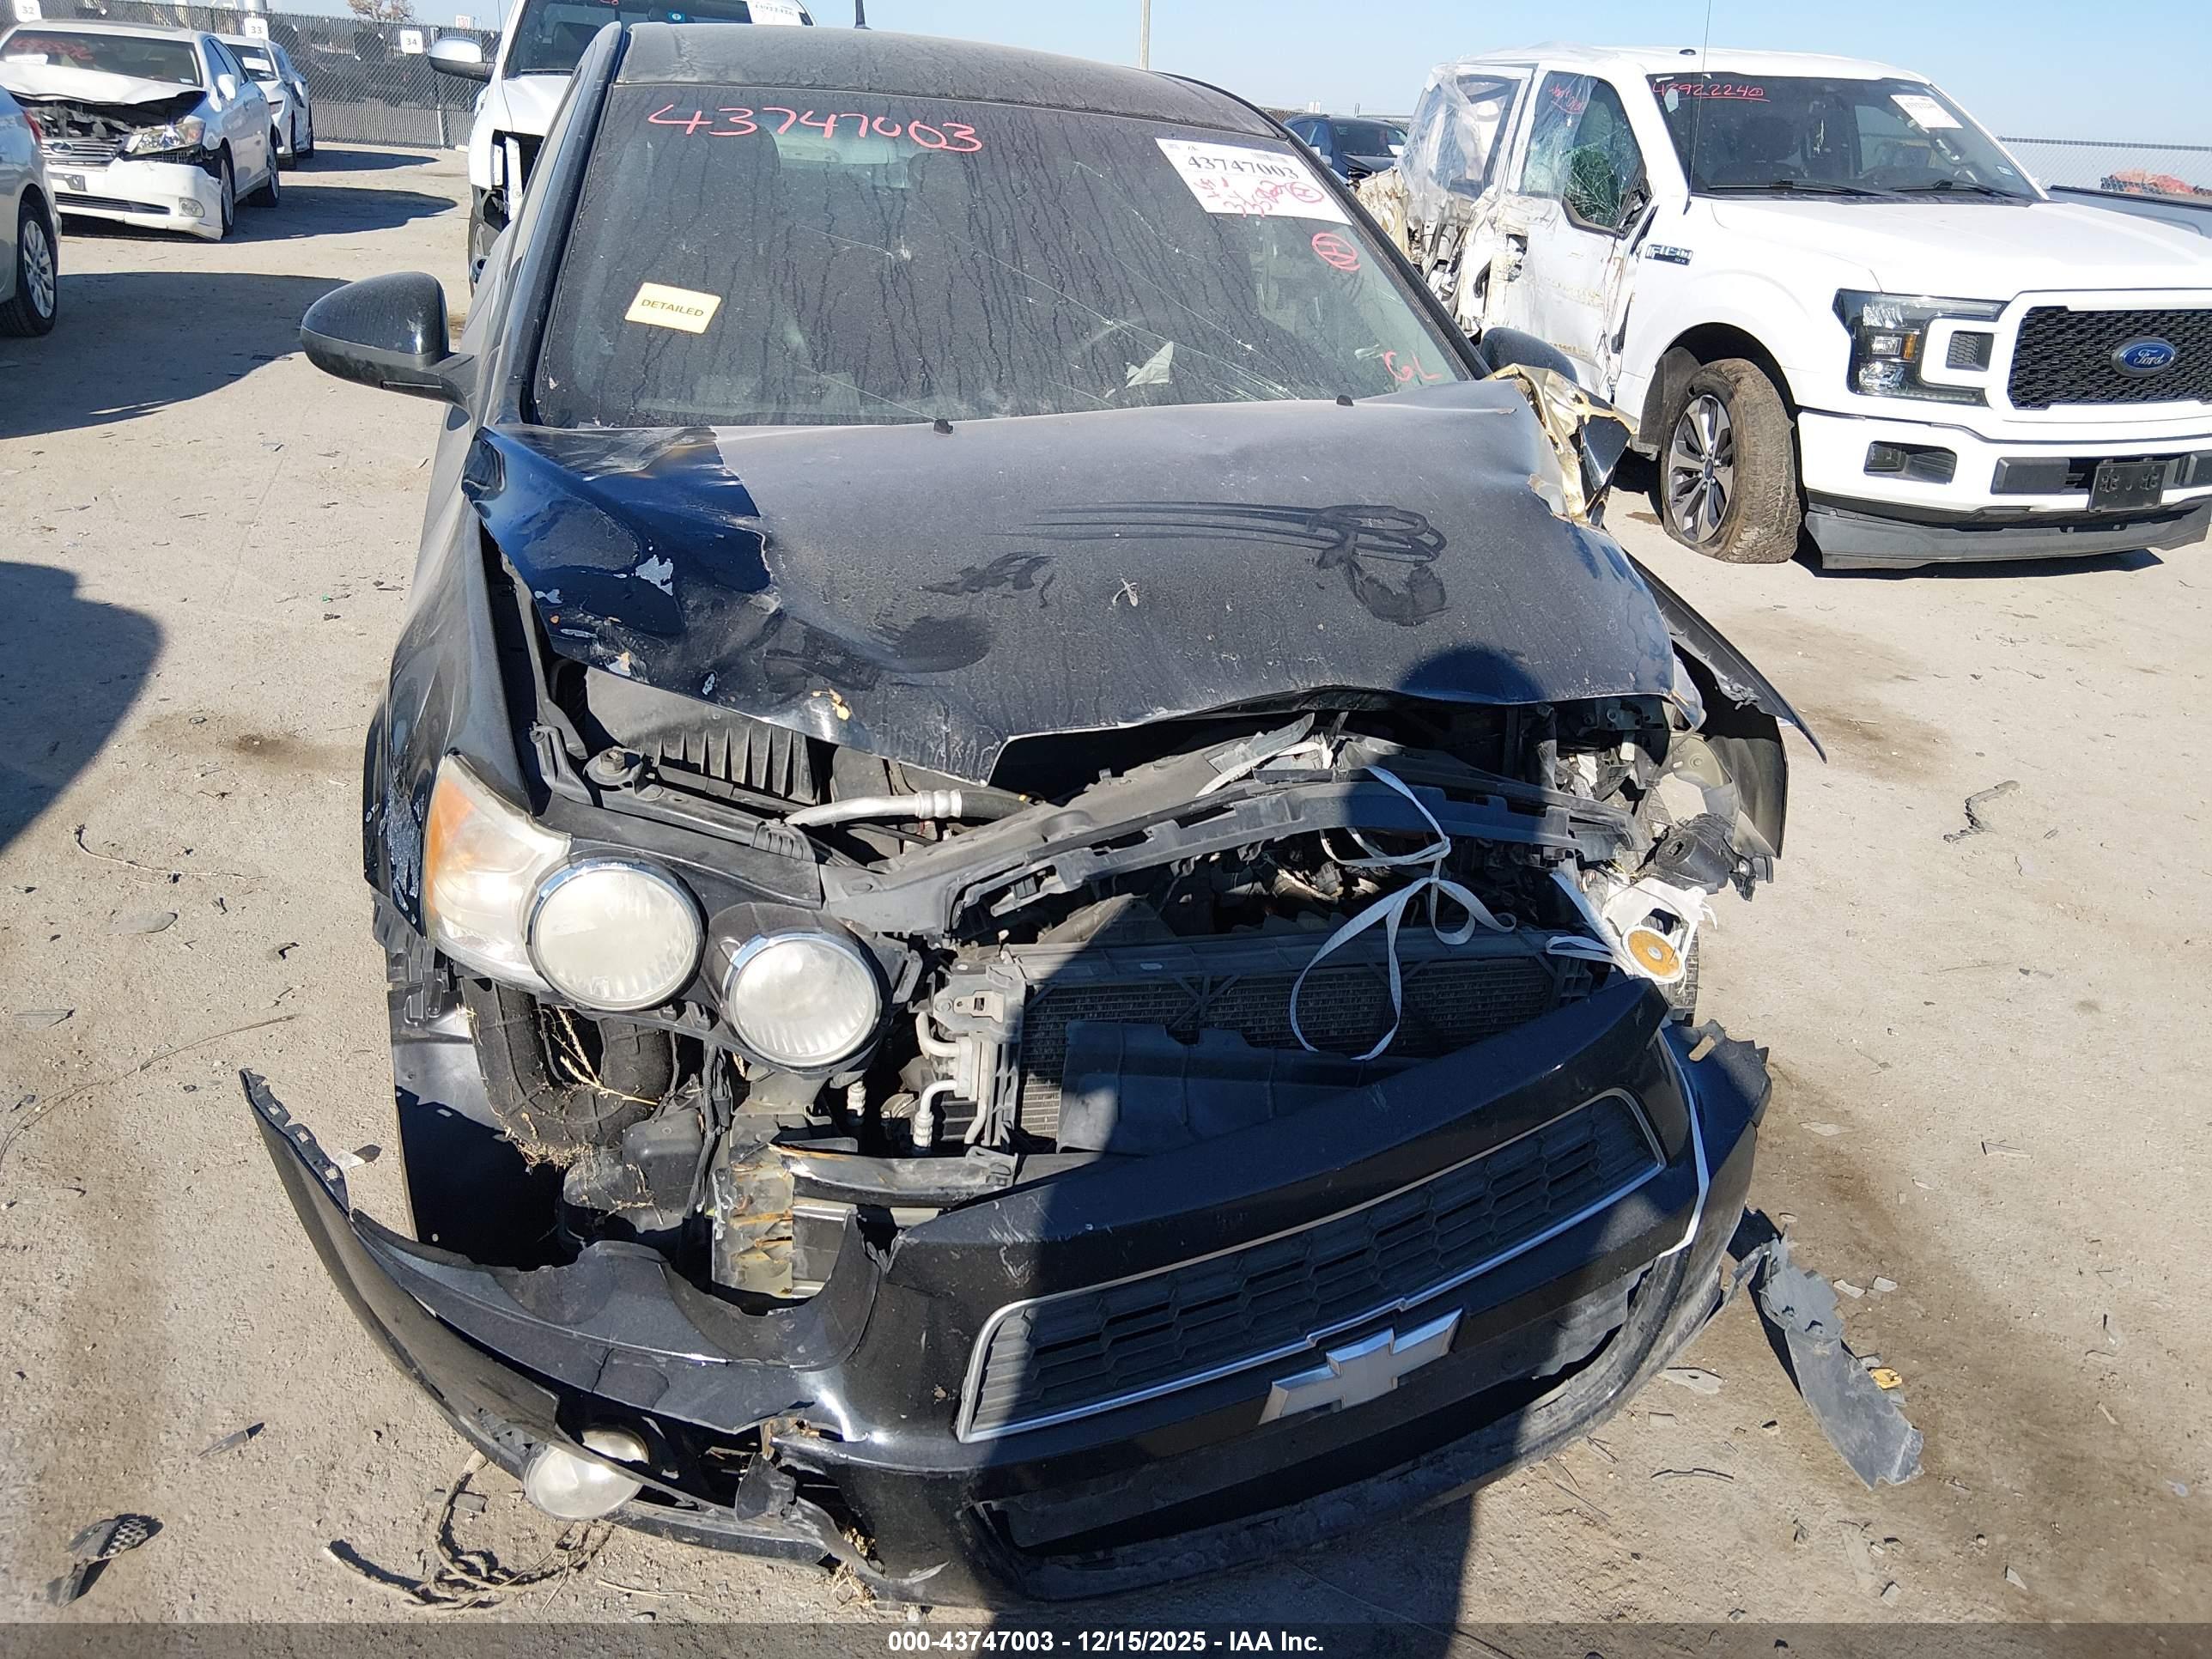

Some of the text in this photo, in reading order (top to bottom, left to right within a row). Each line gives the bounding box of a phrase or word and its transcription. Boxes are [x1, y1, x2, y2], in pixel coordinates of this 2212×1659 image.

[251, 26, 263, 34] 33
[647, 104, 982, 152] 43747003
[1188, 155, 1299, 179] 43747003
[641, 299, 704, 317] DETAILED
[2133, 349, 2165, 365] Ford
